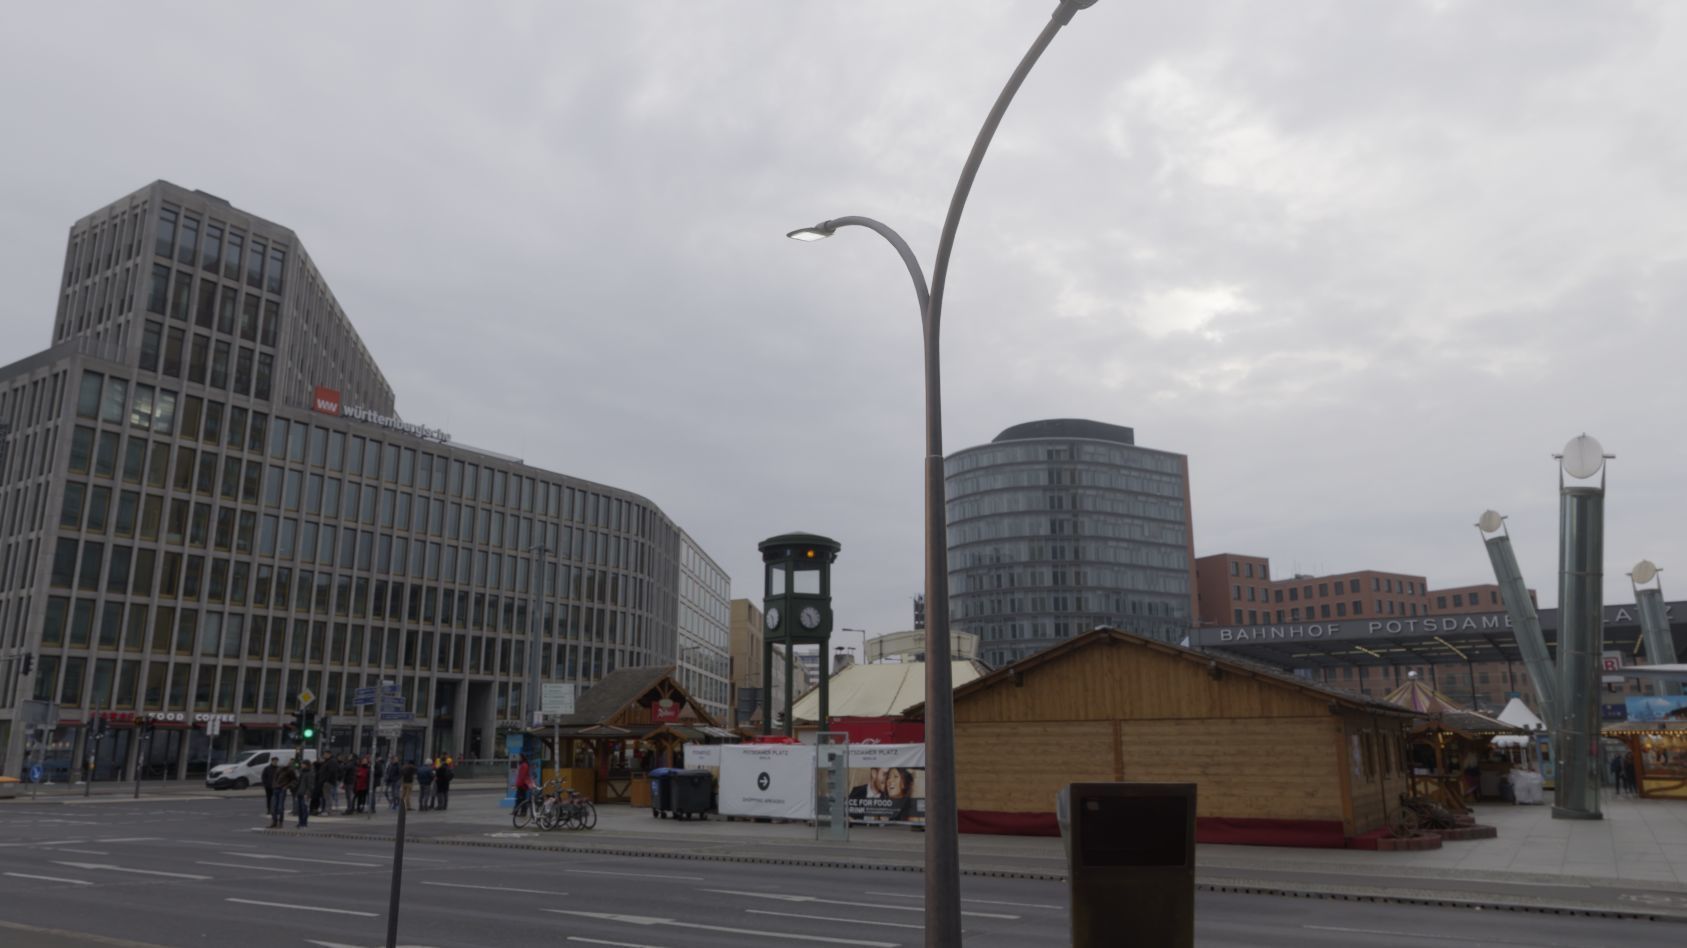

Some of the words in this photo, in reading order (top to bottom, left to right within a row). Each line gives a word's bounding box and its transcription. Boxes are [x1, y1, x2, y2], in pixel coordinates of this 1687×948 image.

[1220, 623, 1341, 641] BAHNHOF
[1368, 615, 1513, 635] POTSDAME
[195, 713, 236, 722] COFFEE
[873, 799, 893, 807] FOOD
